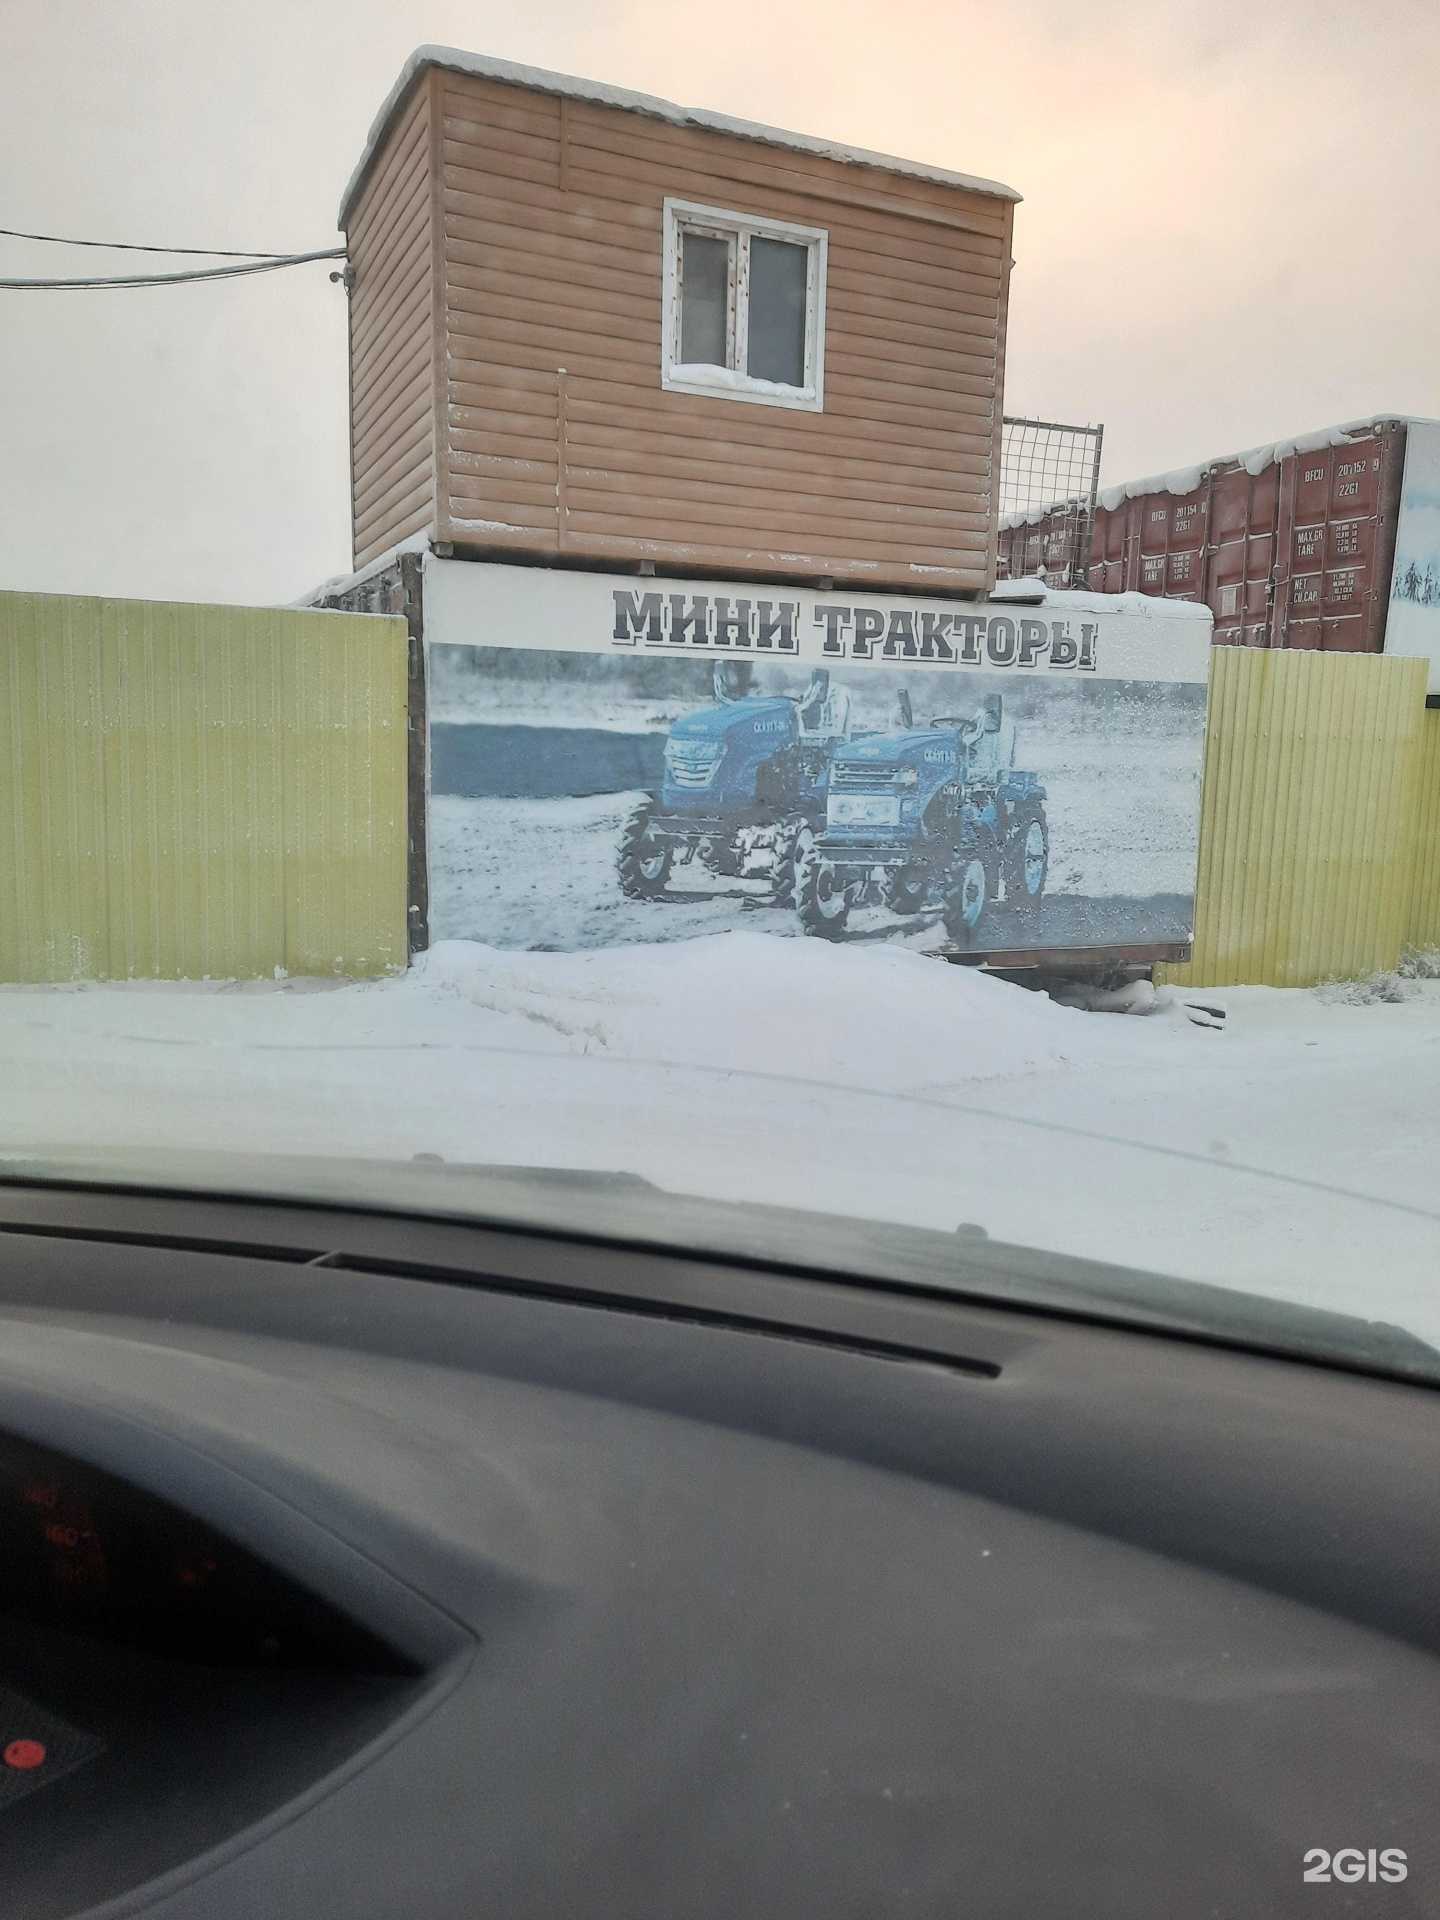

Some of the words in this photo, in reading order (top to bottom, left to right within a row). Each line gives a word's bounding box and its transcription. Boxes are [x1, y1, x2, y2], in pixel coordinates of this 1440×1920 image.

[1304, 468, 1324, 483] BFCU
[1339, 482, 1359, 497] 22G1
[1298, 543, 1314, 556] TARE
[1294, 578, 1307, 590] NET
[612, 590, 799, 655] МИНИ
[813, 604, 1098, 671] ТРАКТОРЫ
